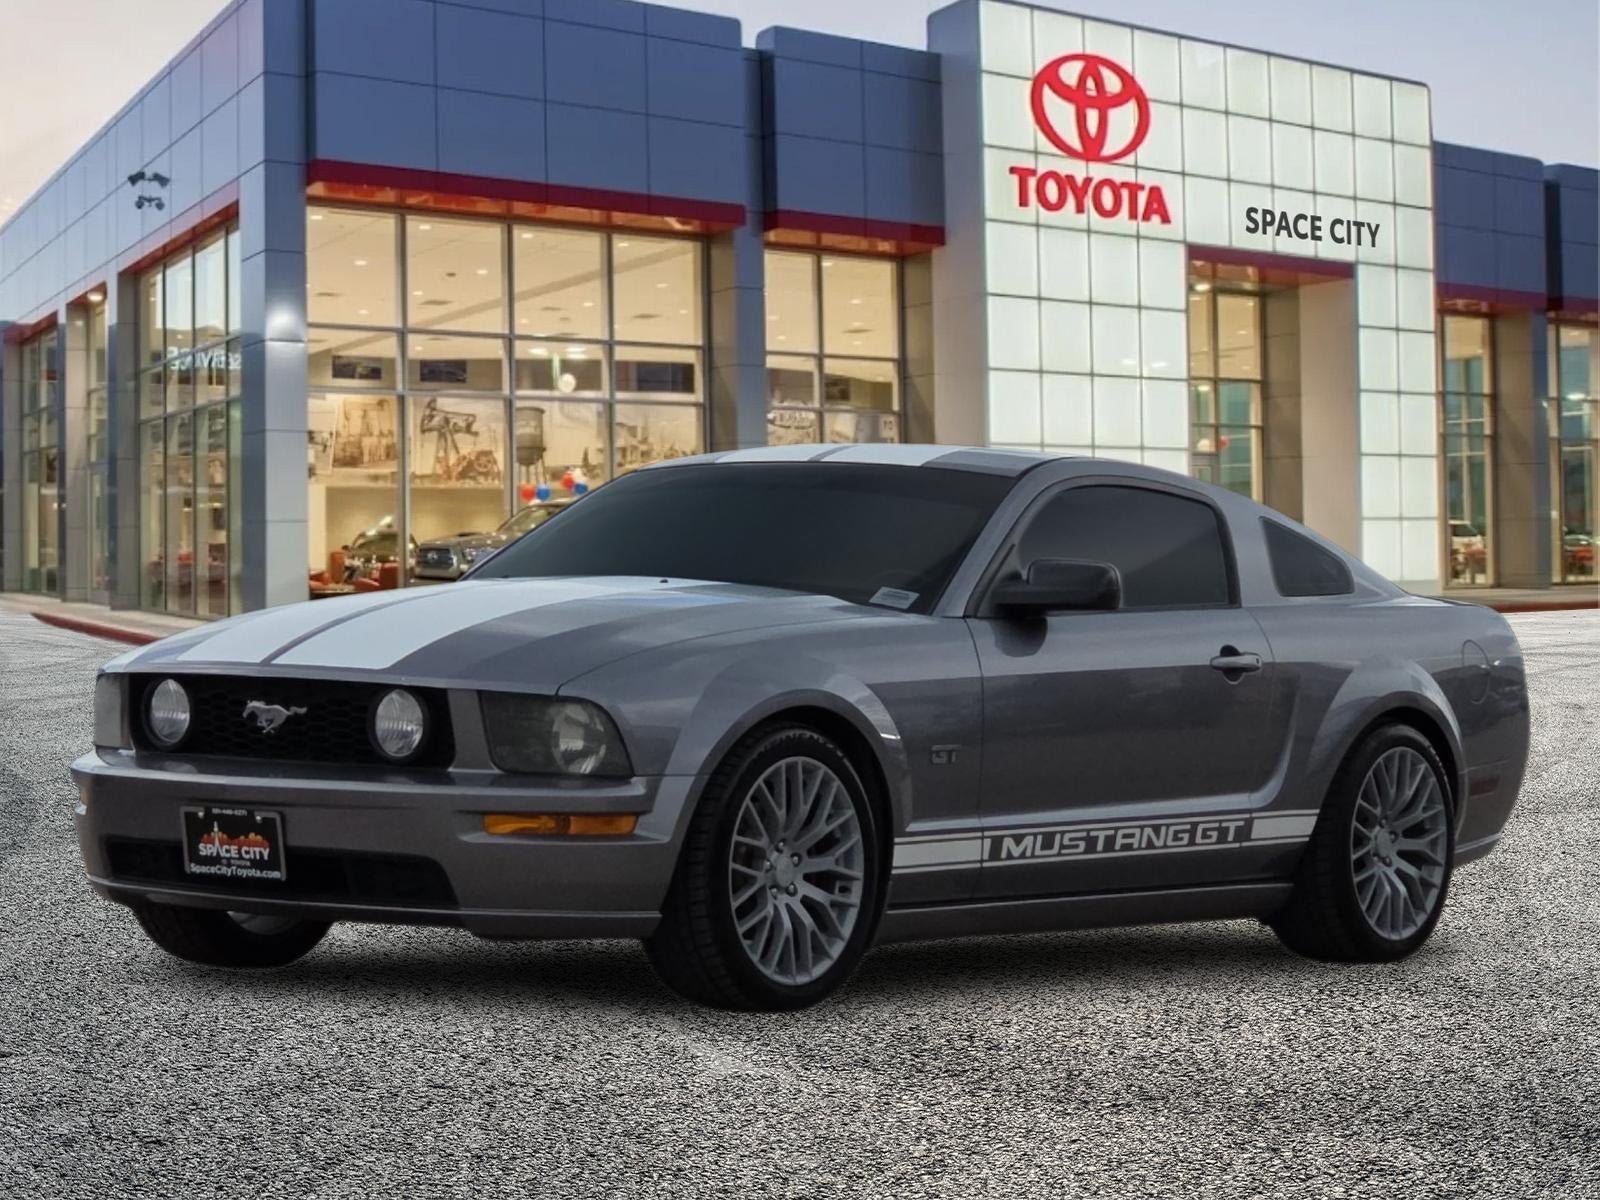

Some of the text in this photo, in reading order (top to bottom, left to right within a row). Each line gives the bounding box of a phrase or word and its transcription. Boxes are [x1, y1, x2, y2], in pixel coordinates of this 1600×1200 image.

[1009, 166, 1172, 224] TOYOTA
[1245, 206, 1381, 248] SPACE CITY
[930, 744, 962, 765] GT
[198, 842, 270, 861] SPACE CITY
[1000, 820, 1245, 859] MUSTANG GT
[190, 863, 281, 879] SpaceCityToyota.com
